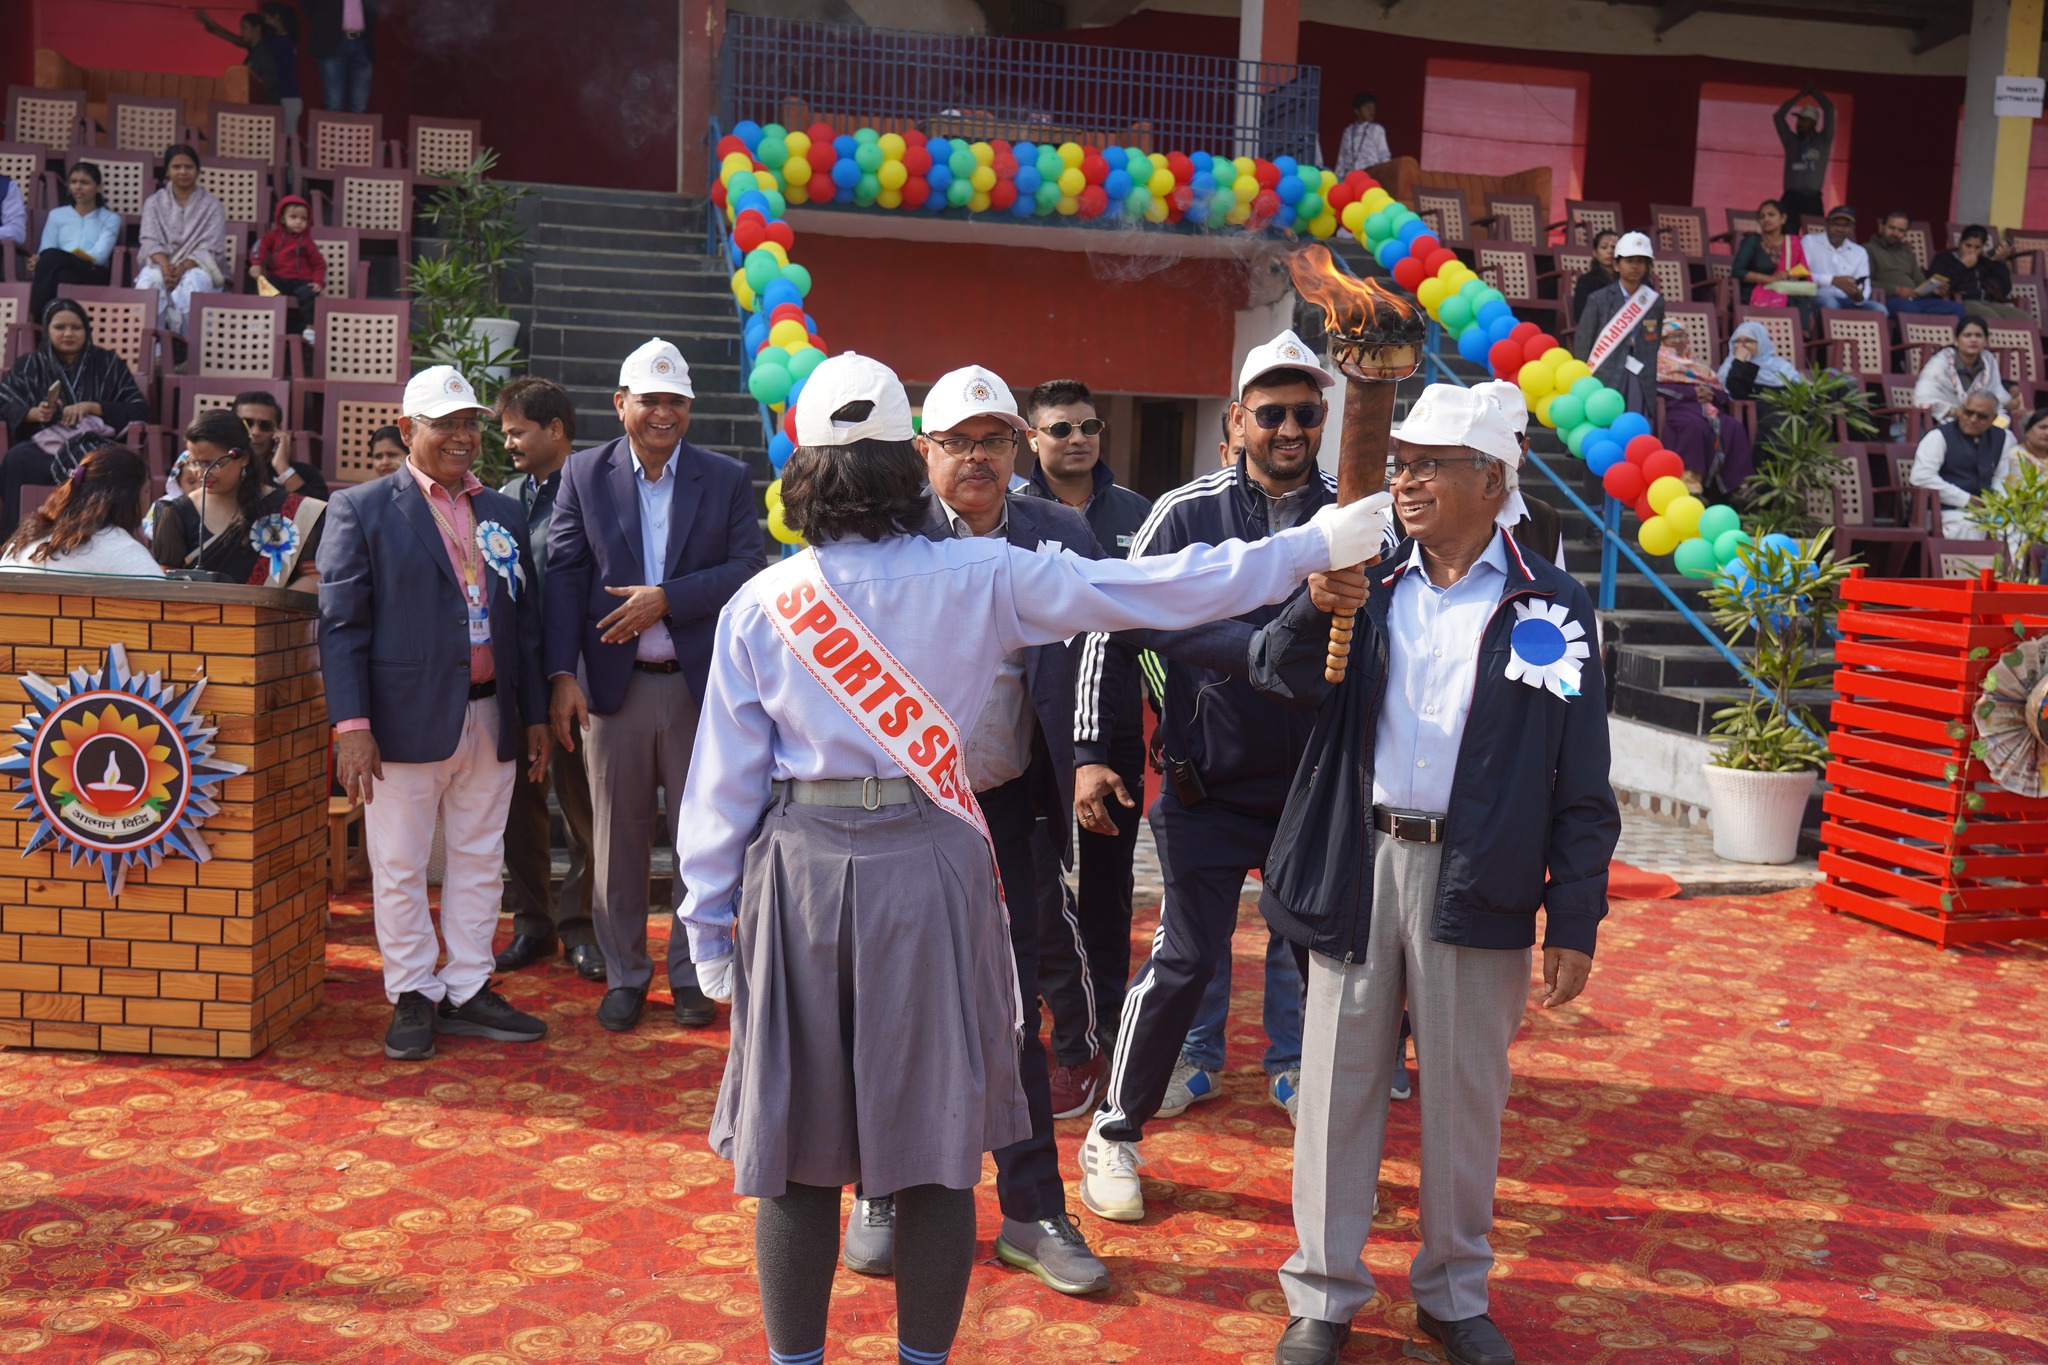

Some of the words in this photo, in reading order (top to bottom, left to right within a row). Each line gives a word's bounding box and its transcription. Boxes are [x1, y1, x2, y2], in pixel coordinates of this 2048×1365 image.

[1593, 303, 1641, 359] DISCIPLINE
[776, 577, 923, 738] SPORTS
[72, 809, 116, 830] आत्मानं
[122, 813, 150, 830] विद्धि
